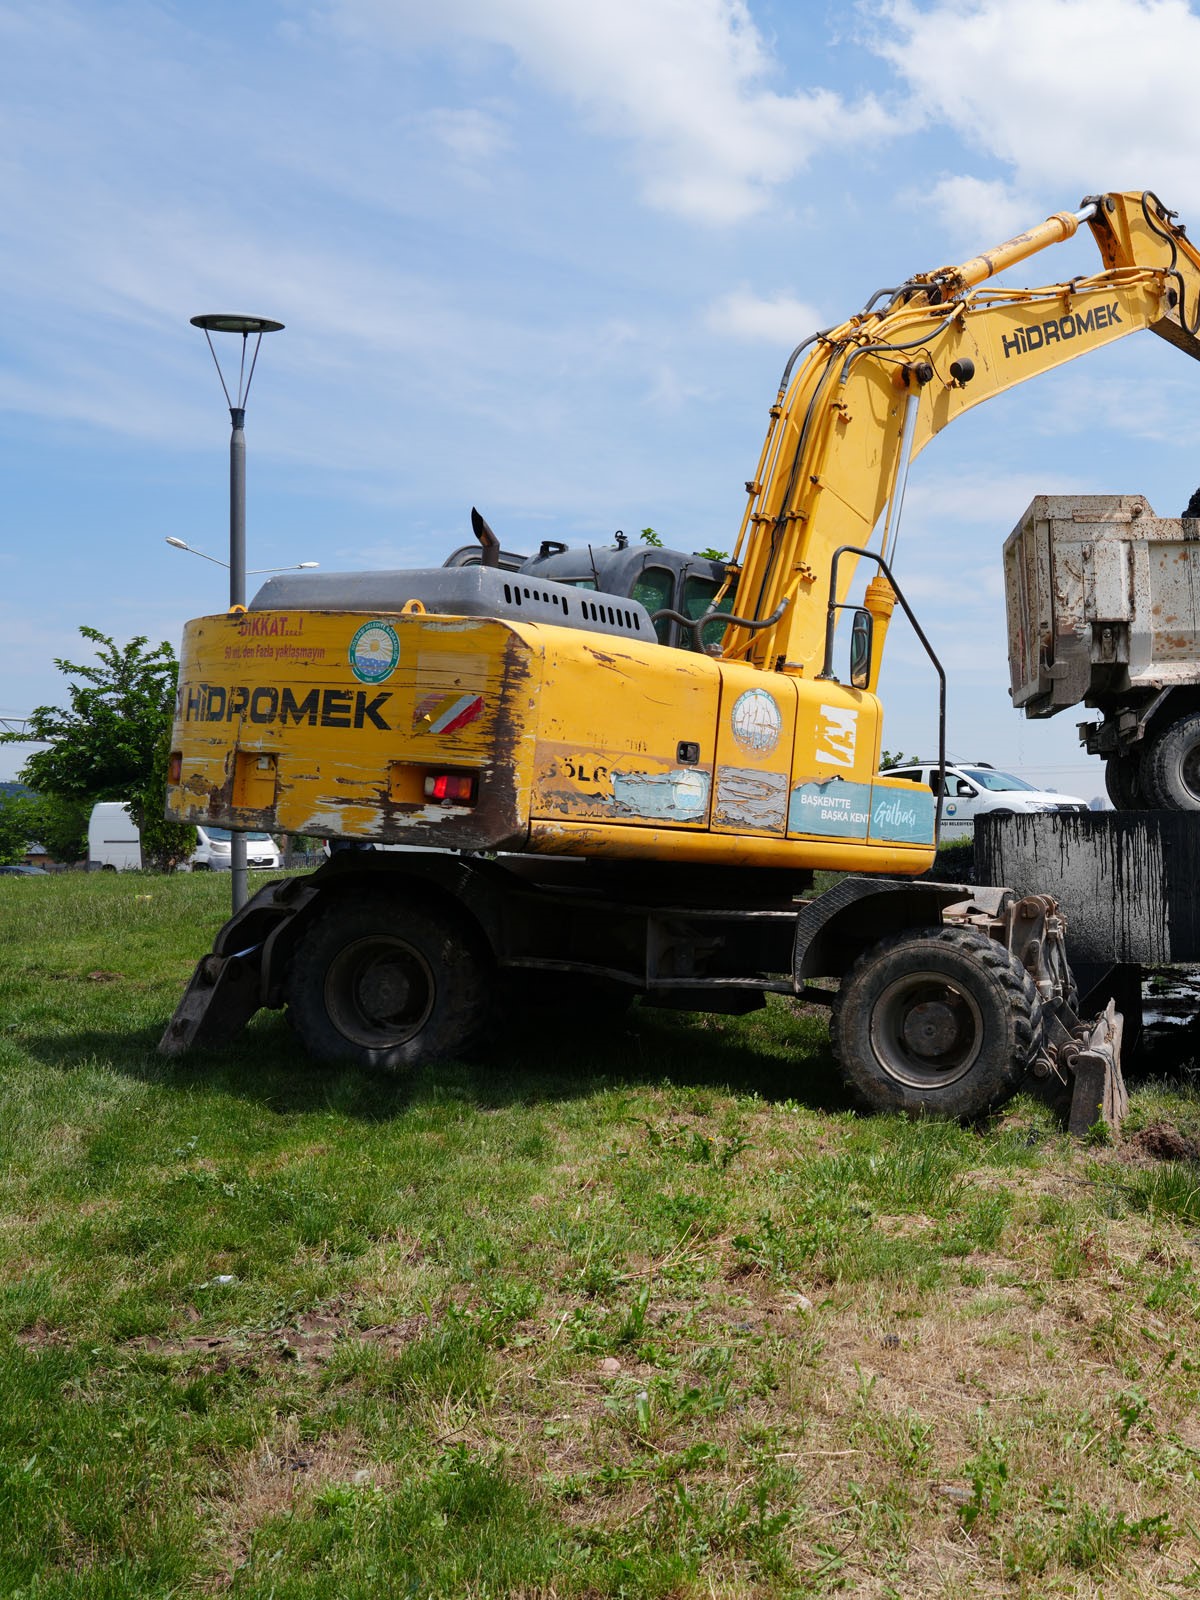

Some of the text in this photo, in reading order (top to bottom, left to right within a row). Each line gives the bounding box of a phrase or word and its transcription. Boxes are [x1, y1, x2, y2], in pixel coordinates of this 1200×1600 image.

[820, 809, 872, 824] BAŞKA KENT
[873, 799, 917, 828] Gölbaşı
